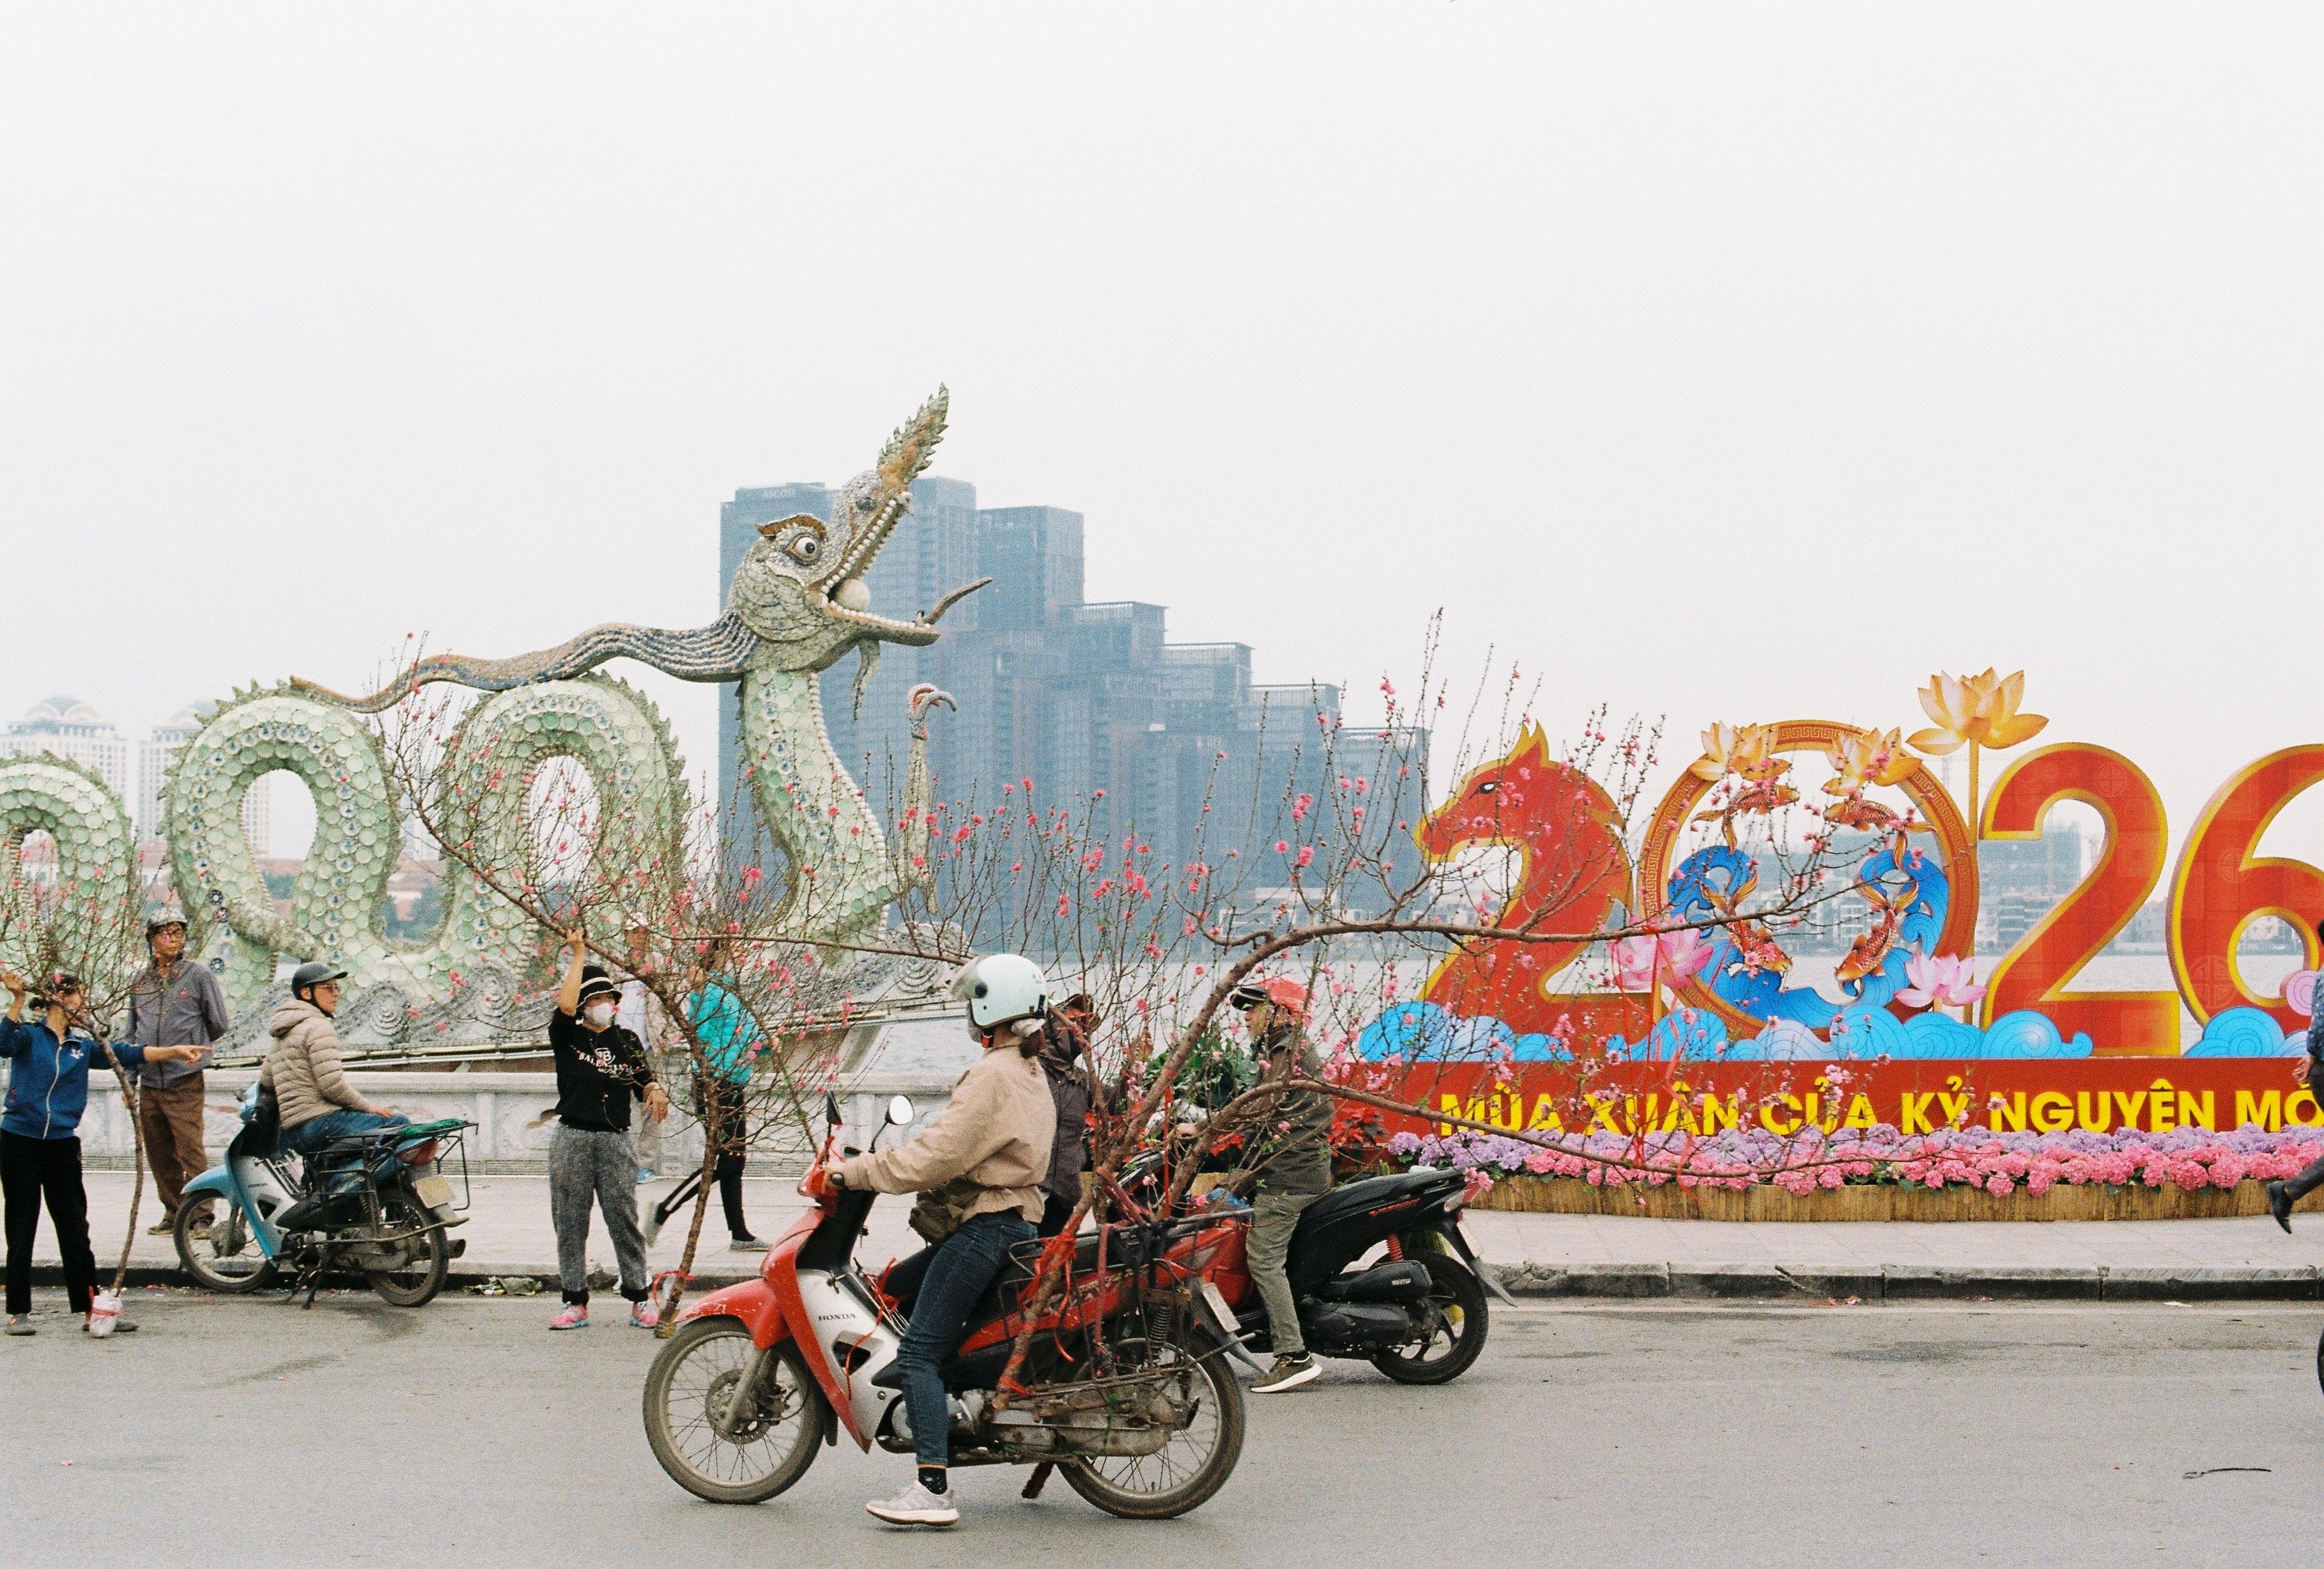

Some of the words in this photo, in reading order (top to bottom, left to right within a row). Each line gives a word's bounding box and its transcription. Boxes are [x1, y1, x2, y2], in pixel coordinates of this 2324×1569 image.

[1440, 1081, 1565, 1136] MÙA
[1582, 1080, 1739, 1136] XUÂN
[1759, 1076, 1879, 1136] CỦA
[1901, 1075, 1971, 1135] KỶ
[1989, 1078, 2215, 1133] NGUYÊN
[818, 1313, 857, 1322] HONDA
